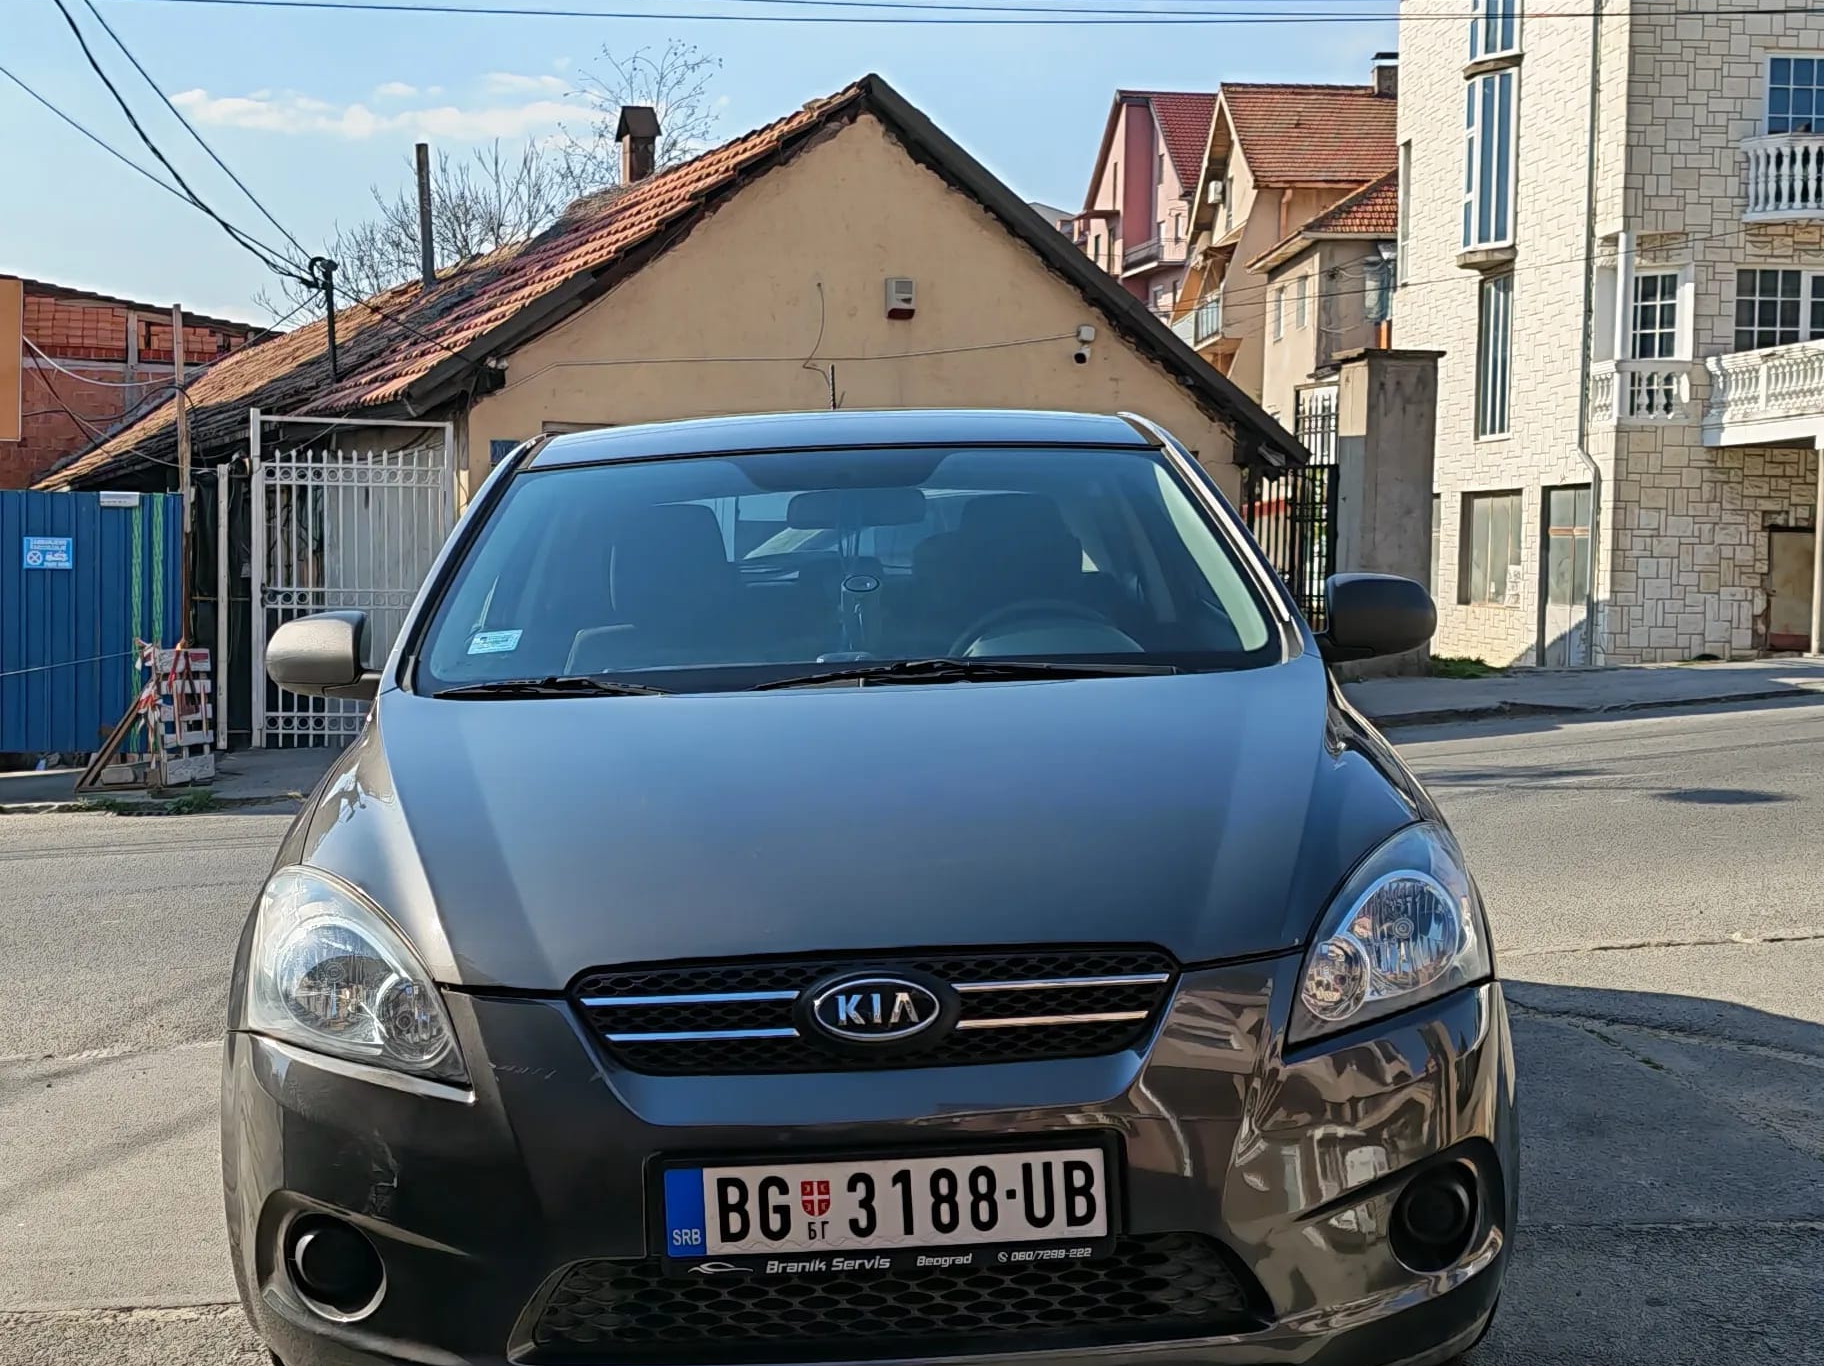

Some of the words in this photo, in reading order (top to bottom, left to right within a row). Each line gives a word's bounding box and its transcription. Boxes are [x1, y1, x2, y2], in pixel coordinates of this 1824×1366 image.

[835, 992, 920, 1026] KIA
[716, 1175, 792, 1243] BG
[672, 1228, 702, 1246] SRB
[766, 1258, 827, 1274] Branik
[831, 1255, 891, 1271] Servis
[916, 1252, 973, 1268] Beograd
